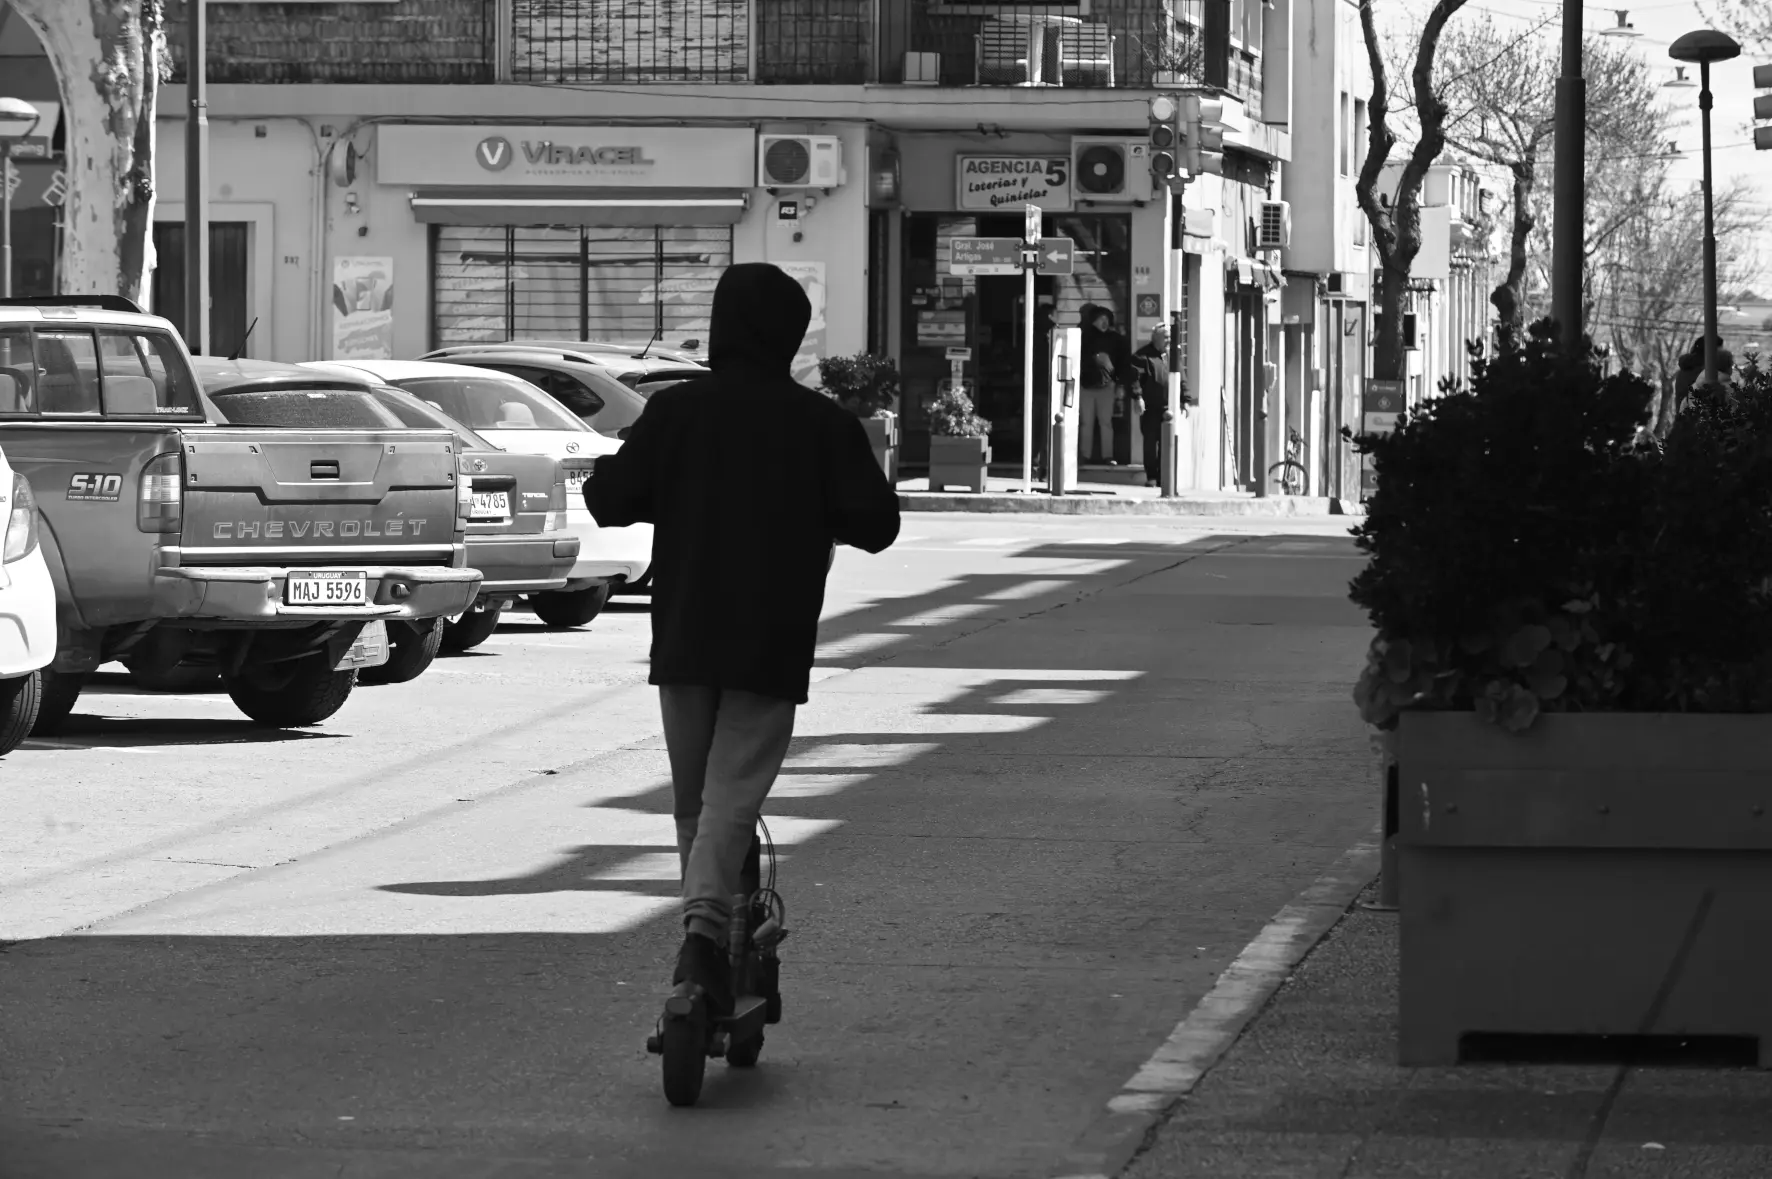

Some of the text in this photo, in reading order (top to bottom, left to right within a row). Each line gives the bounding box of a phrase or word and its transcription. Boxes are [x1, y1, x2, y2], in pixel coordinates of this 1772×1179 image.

[965, 160, 1067, 187] AGENCIA 5
[989, 188, 1048, 208] Quinielas
[955, 252, 982, 263] Artigas
[69, 474, 122, 495] S-10
[480, 494, 506, 508] 4785
[213, 519, 427, 539] CHEVROLET
[293, 582, 361, 601] MAJ 5596
